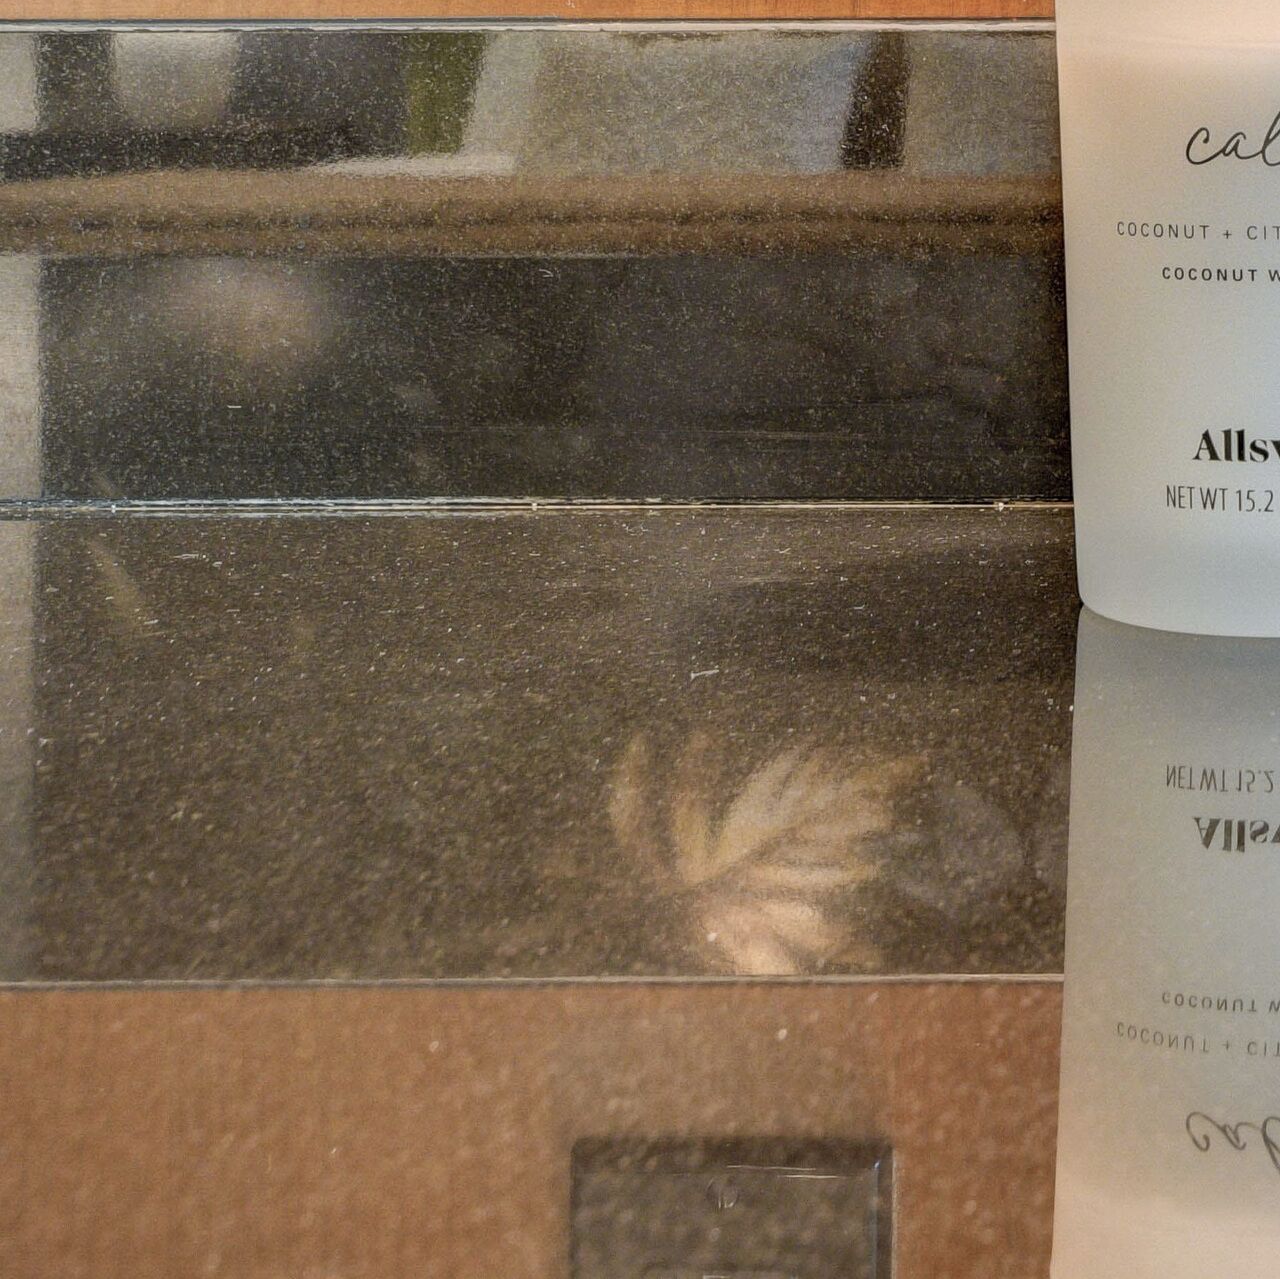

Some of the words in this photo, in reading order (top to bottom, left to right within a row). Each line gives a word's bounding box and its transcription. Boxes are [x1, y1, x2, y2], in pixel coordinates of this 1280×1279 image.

[1116, 221, 1211, 240] COCONUT
[1161, 267, 1258, 282] COCONUT
[1166, 485, 1195, 510] NET
[1200, 487, 1228, 511] WT
[1236, 489, 1274, 513] 15.2
